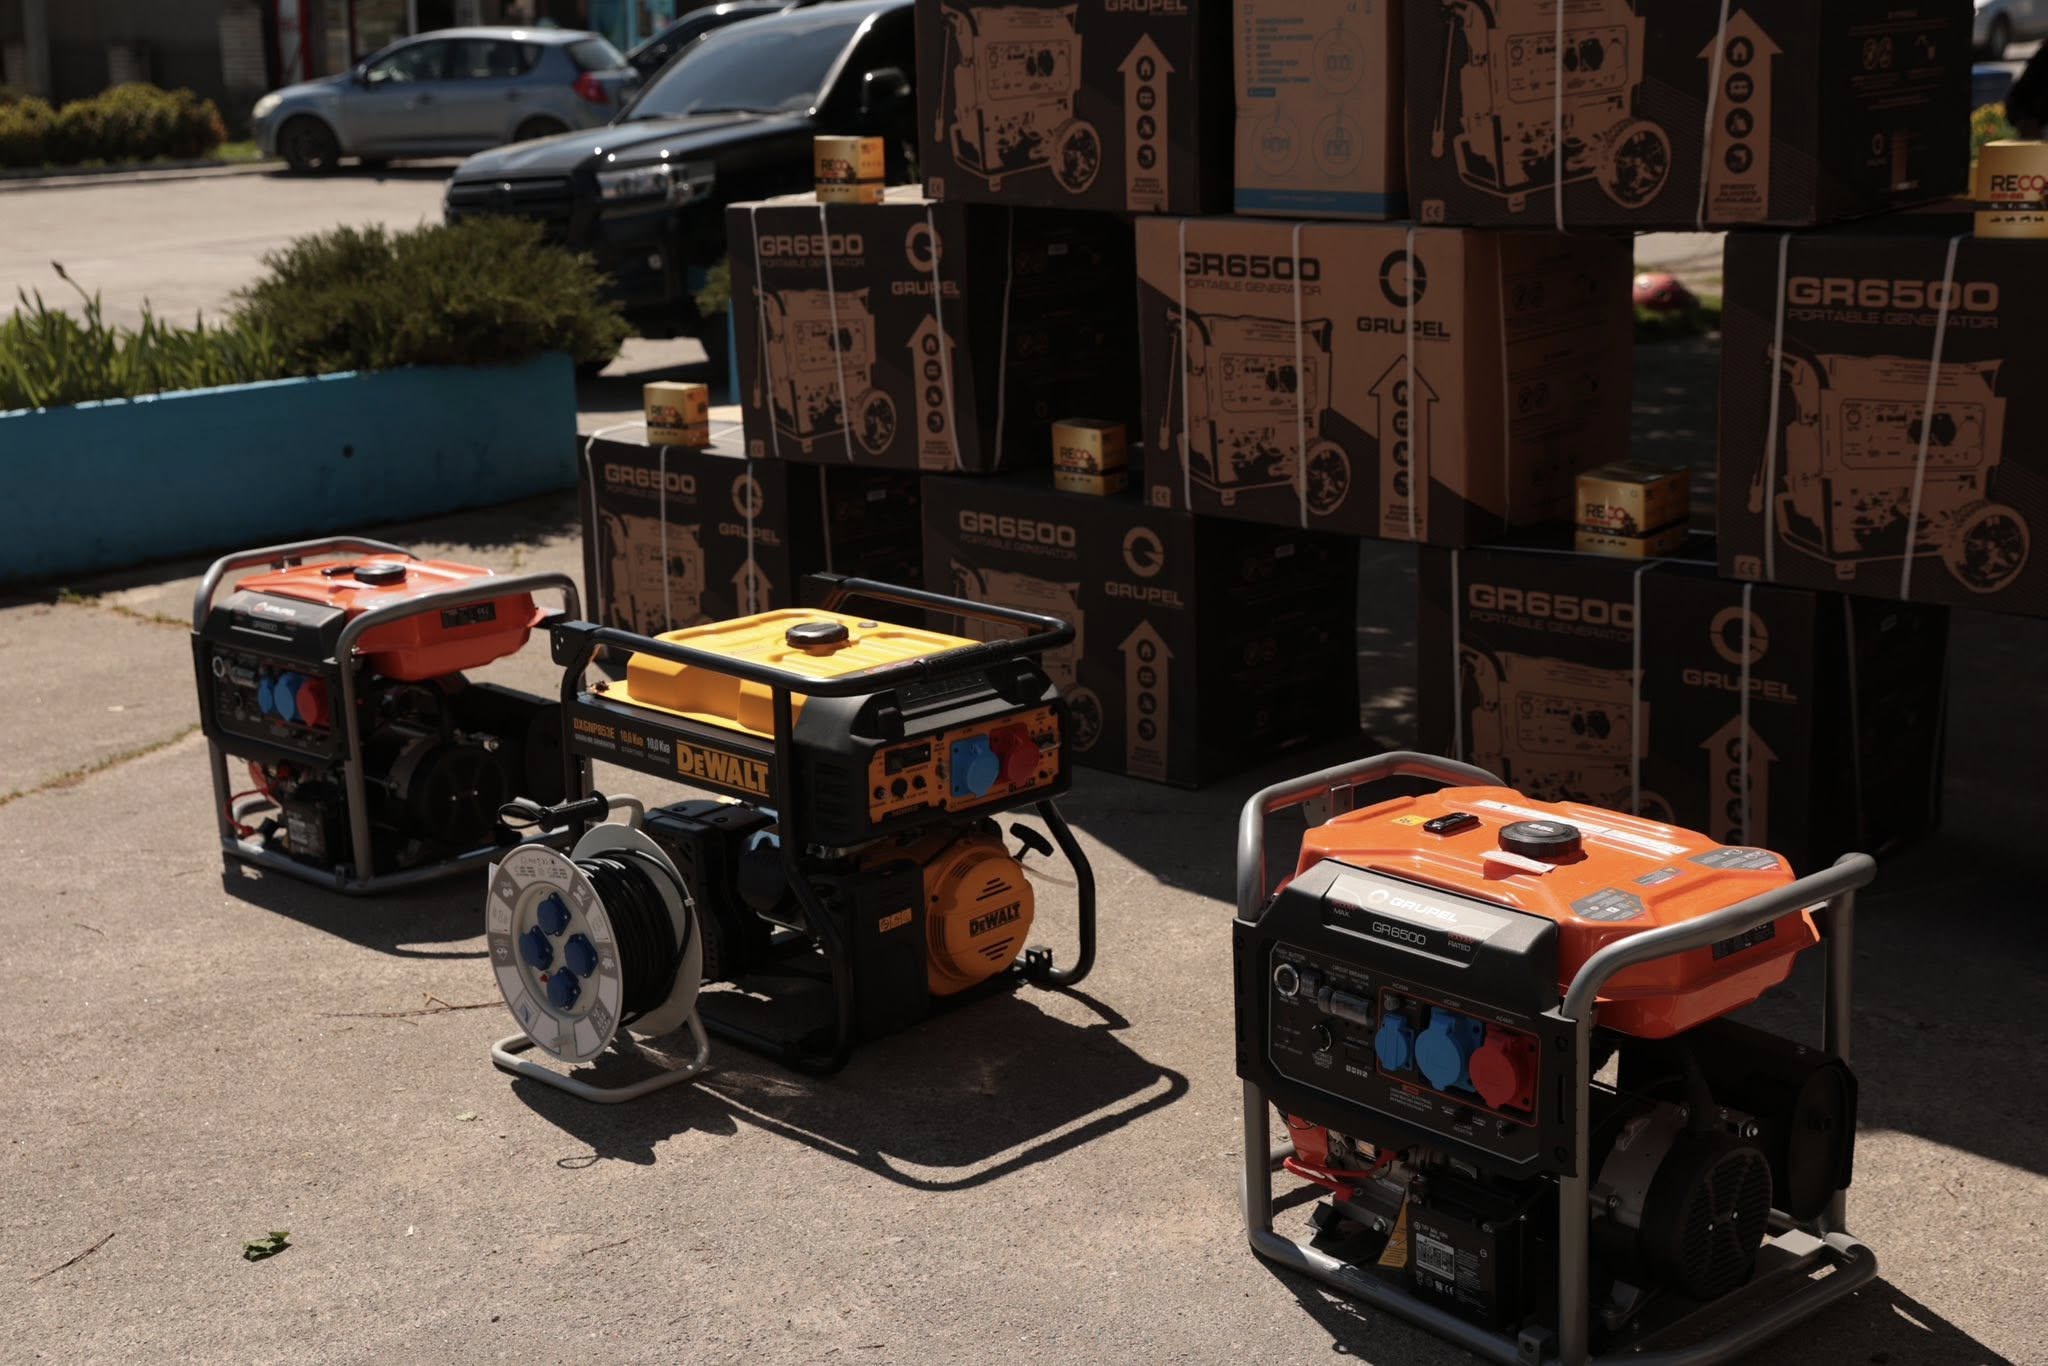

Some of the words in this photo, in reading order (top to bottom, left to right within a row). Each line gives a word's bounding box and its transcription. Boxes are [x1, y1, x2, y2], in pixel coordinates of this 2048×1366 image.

[1991, 175, 2045, 192] RECO
[758, 233, 865, 257] GR6500
[1245, 281, 1322, 297] GENERAOR
[1787, 276, 2000, 313] GR6500
[1787, 307, 1881, 325] PORTABLE
[604, 463, 697, 495] GR6500
[959, 509, 1076, 548] GR6500
[1105, 581, 1184, 607] GRUPEL
[1469, 583, 1635, 628] GR6500
[1390, 897, 1458, 923] GRUPEL
[1372, 921, 1427, 946] GR6500
